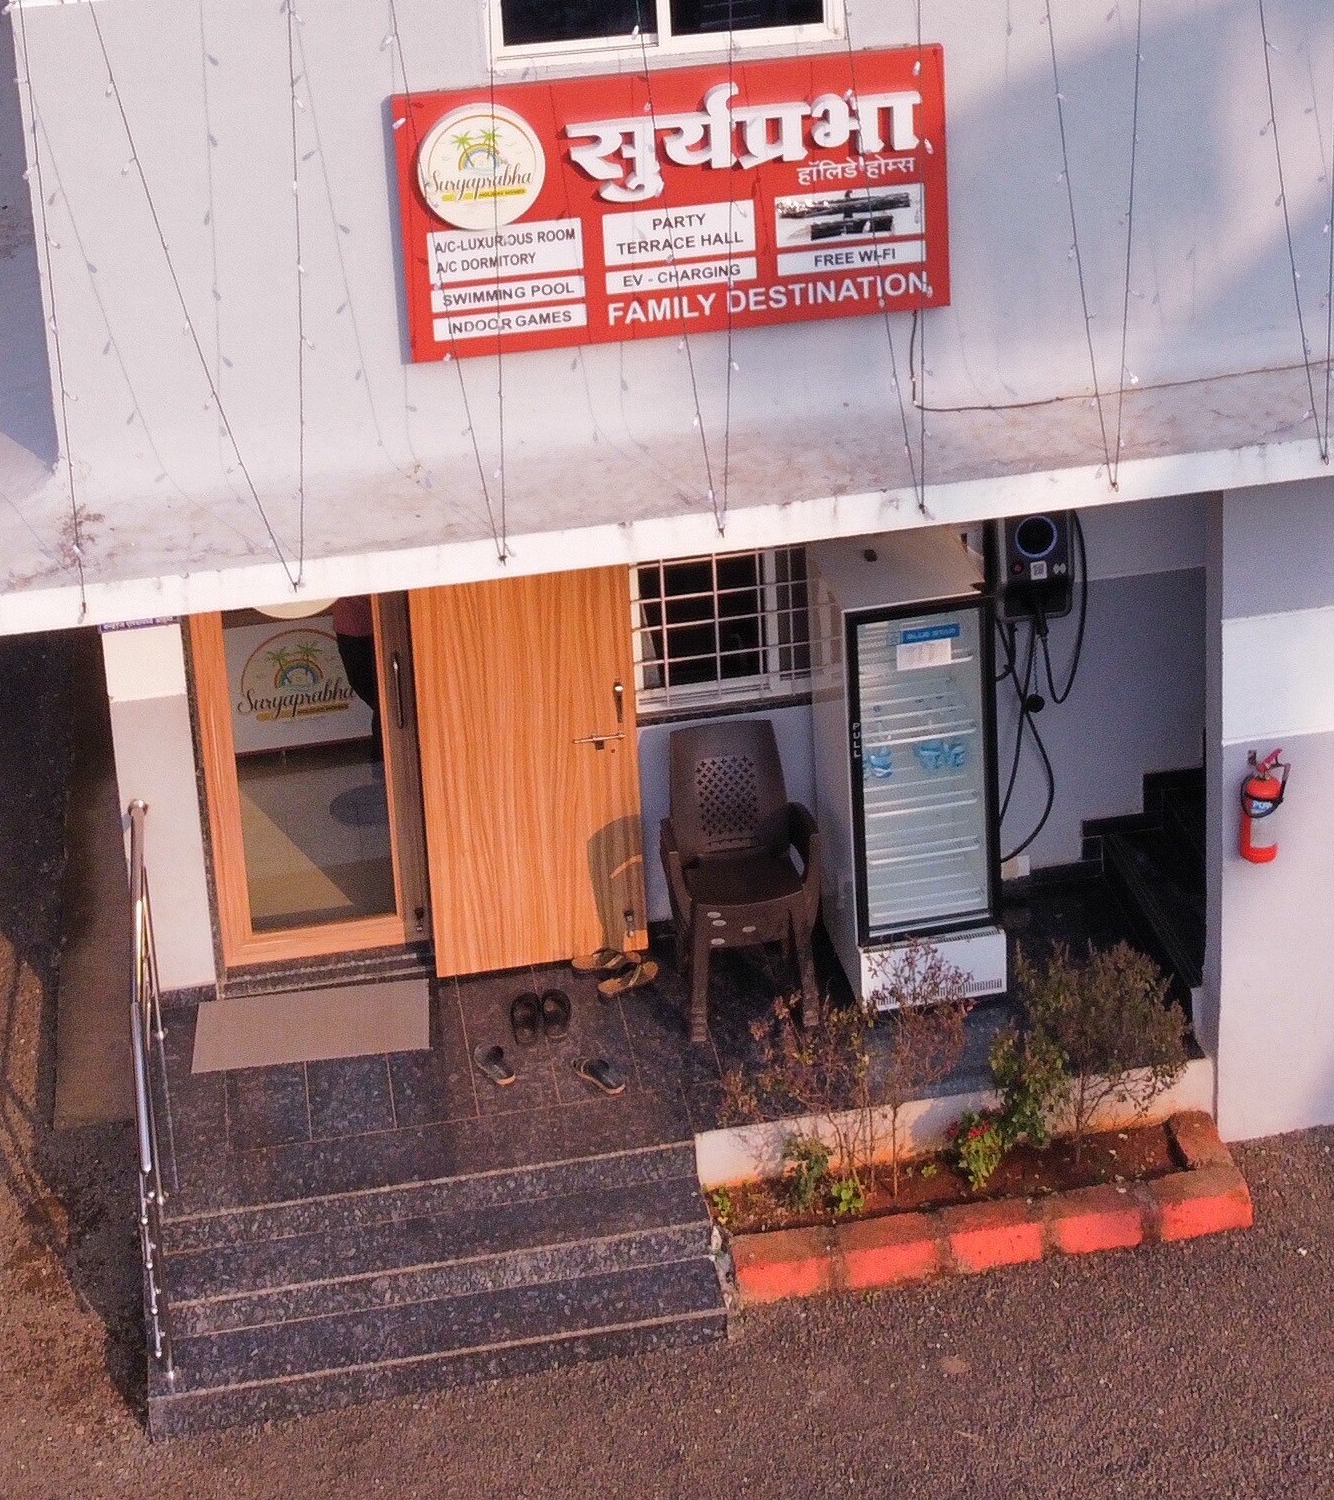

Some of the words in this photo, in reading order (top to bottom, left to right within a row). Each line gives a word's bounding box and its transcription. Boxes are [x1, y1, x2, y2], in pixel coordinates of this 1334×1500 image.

[565, 81, 922, 203] सुर्यप्रभा
[425, 163, 533, 201] Suryaprabha
[796, 157, 857, 185] हॉलिडे
[866, 155, 915, 178] होम्स
[652, 213, 706, 231] PARTY
[537, 228, 576, 244] ROOM
[617, 236, 695, 255] TERRACE
[701, 231, 744, 246] HALL
[436, 261, 458, 274] A/C
[461, 252, 537, 270] DORMITORY
[814, 252, 855, 267] FREE
[859, 248, 896, 262] WI-FI
[623, 274, 643, 287] EV
[657, 264, 741, 284] CHARGING
[443, 287, 526, 307] SWIMMING
[531, 282, 574, 297] POOL
[608, 293, 717, 326] FAMILY
[727, 270, 928, 314] DESTINATION
[448, 318, 512, 334] INDOOR
[515, 310, 572, 327] GAMES
[237, 677, 357, 719] Suryaprabha
[852, 722, 861, 758] PULL
